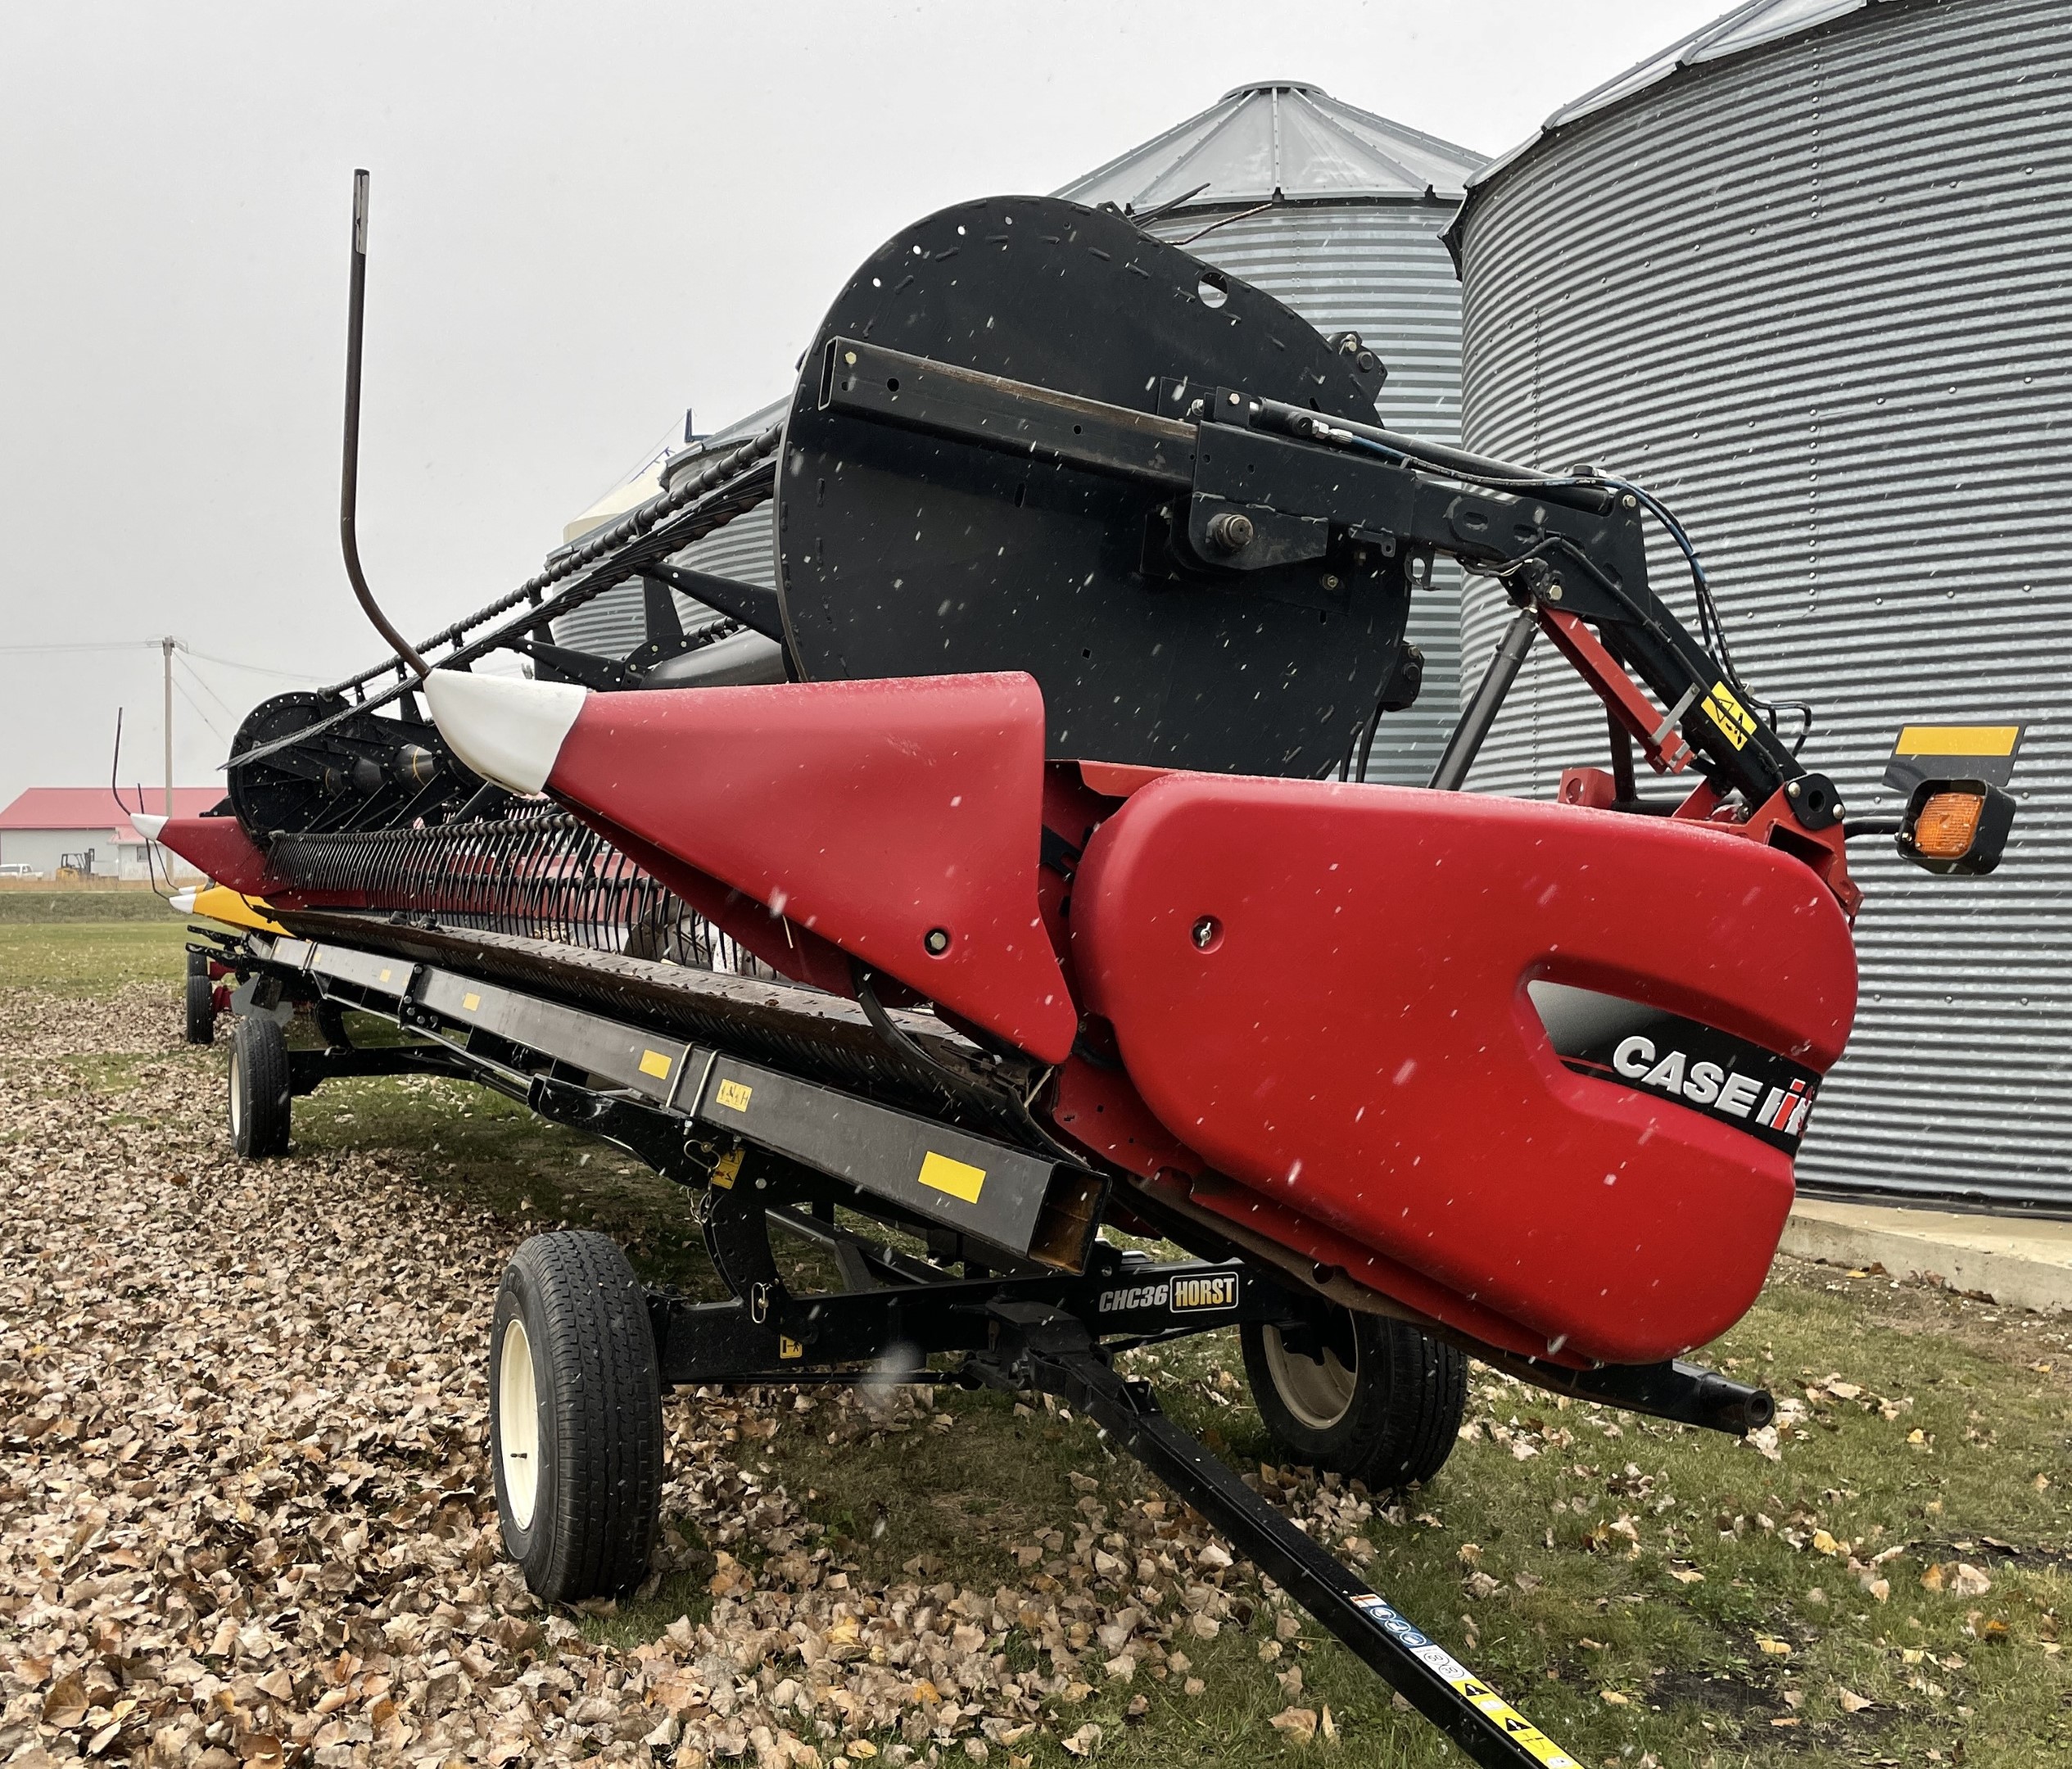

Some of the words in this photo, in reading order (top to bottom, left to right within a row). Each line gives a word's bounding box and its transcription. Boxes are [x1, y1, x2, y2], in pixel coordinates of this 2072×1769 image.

[1613, 1035, 1763, 1119] CASE
[1099, 1284, 1169, 1312] CHC36
[1176, 1278, 1235, 1307] HORST
